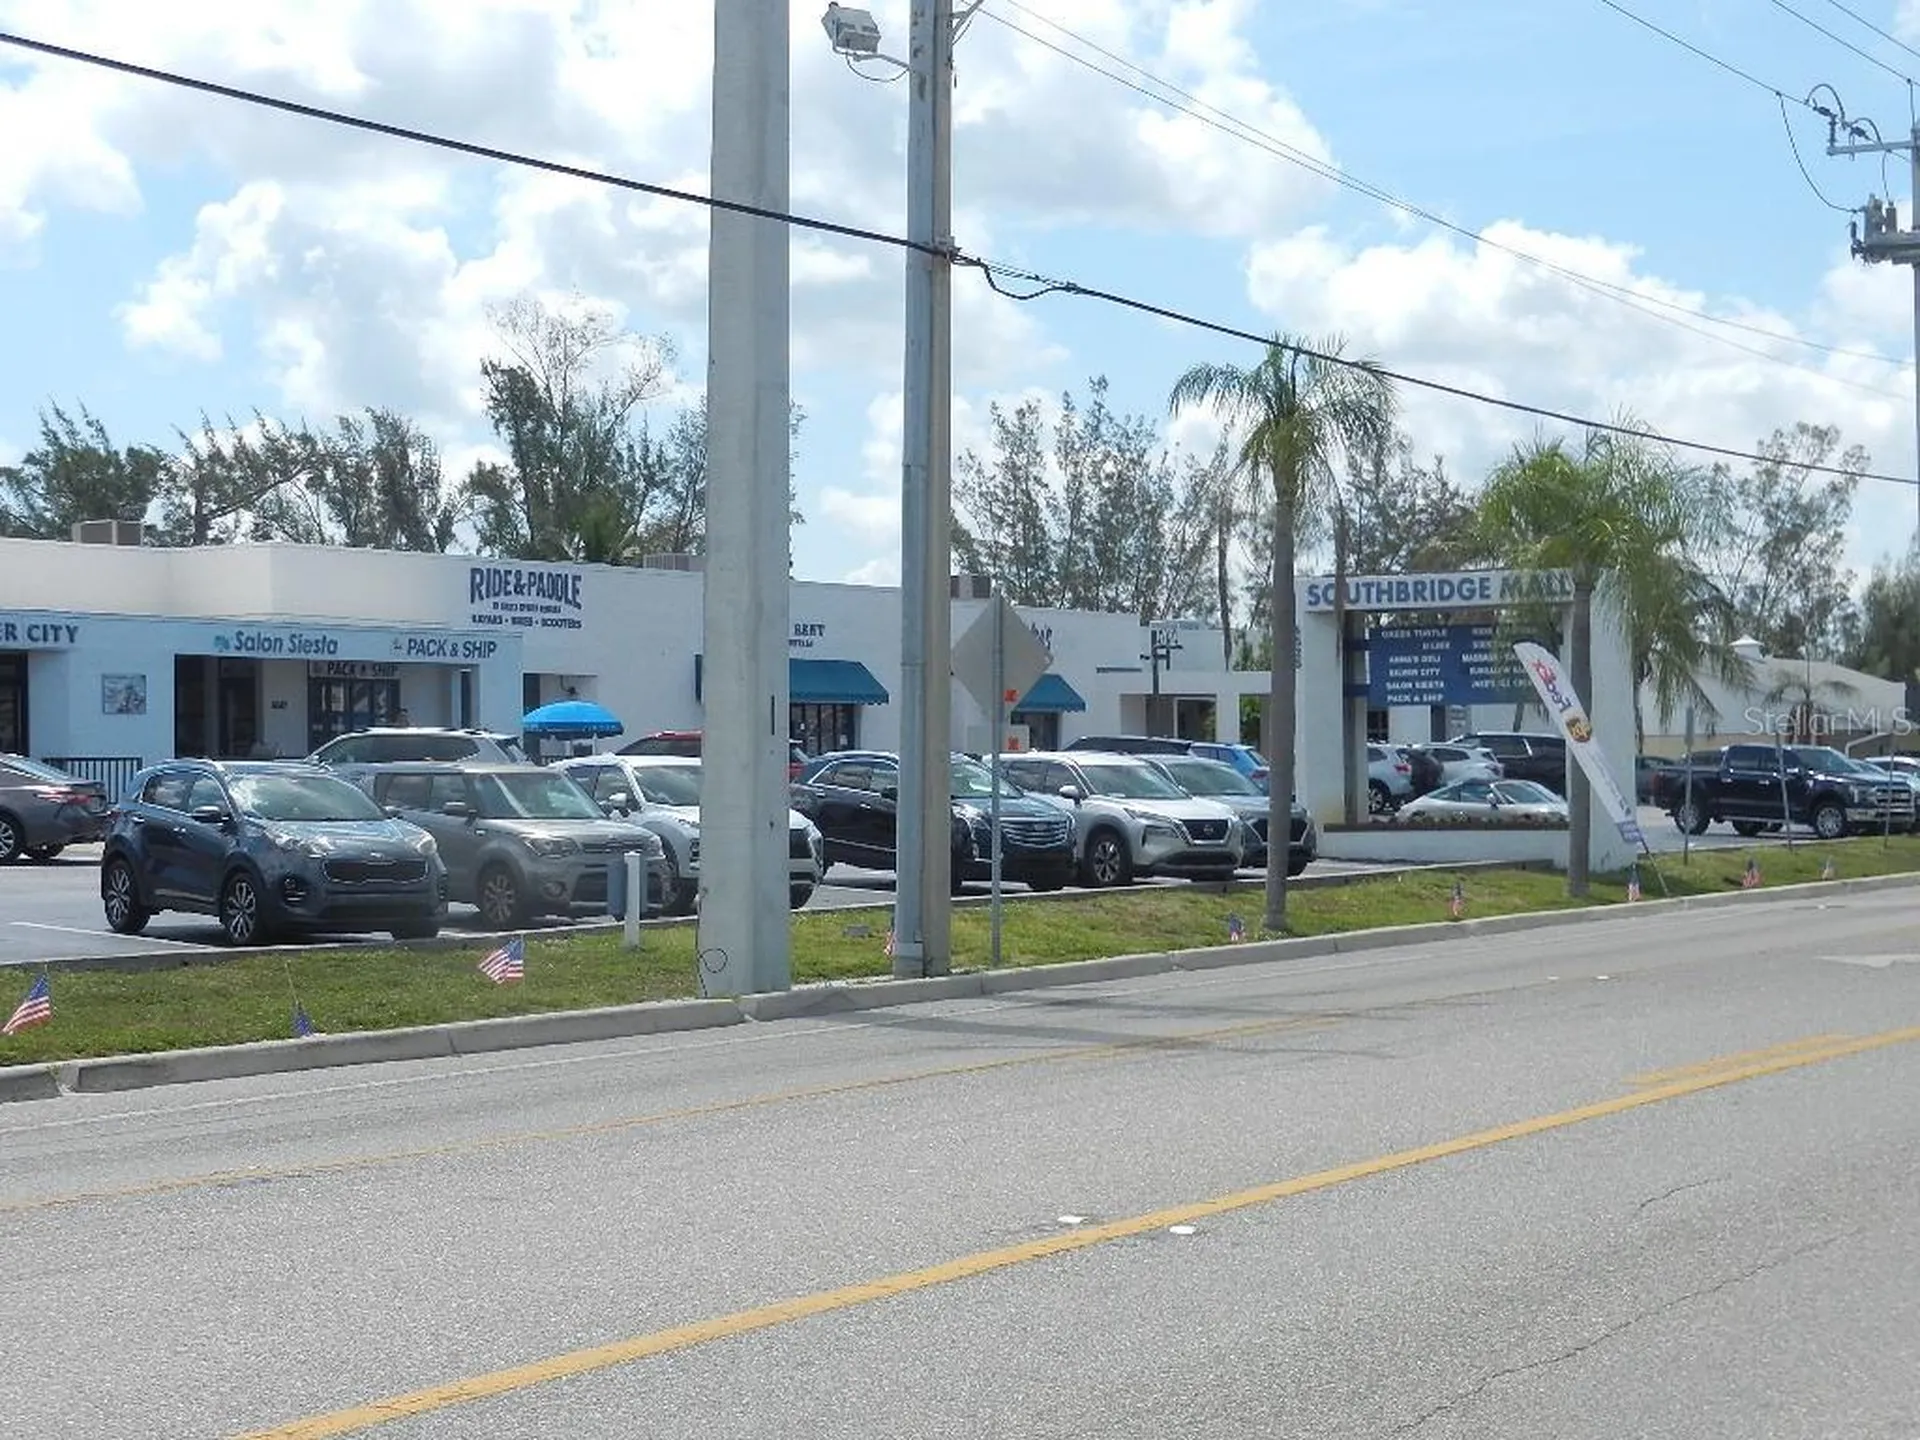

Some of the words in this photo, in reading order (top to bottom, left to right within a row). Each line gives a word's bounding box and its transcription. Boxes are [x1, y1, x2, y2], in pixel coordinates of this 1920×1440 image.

[27, 624, 79, 643] CITY
[234, 631, 283, 653] Salon
[288, 634, 338, 655] Siesta
[407, 638, 447, 657] PACK
[450, 643, 458, 657] &
[462, 641, 497, 659] SHIP
